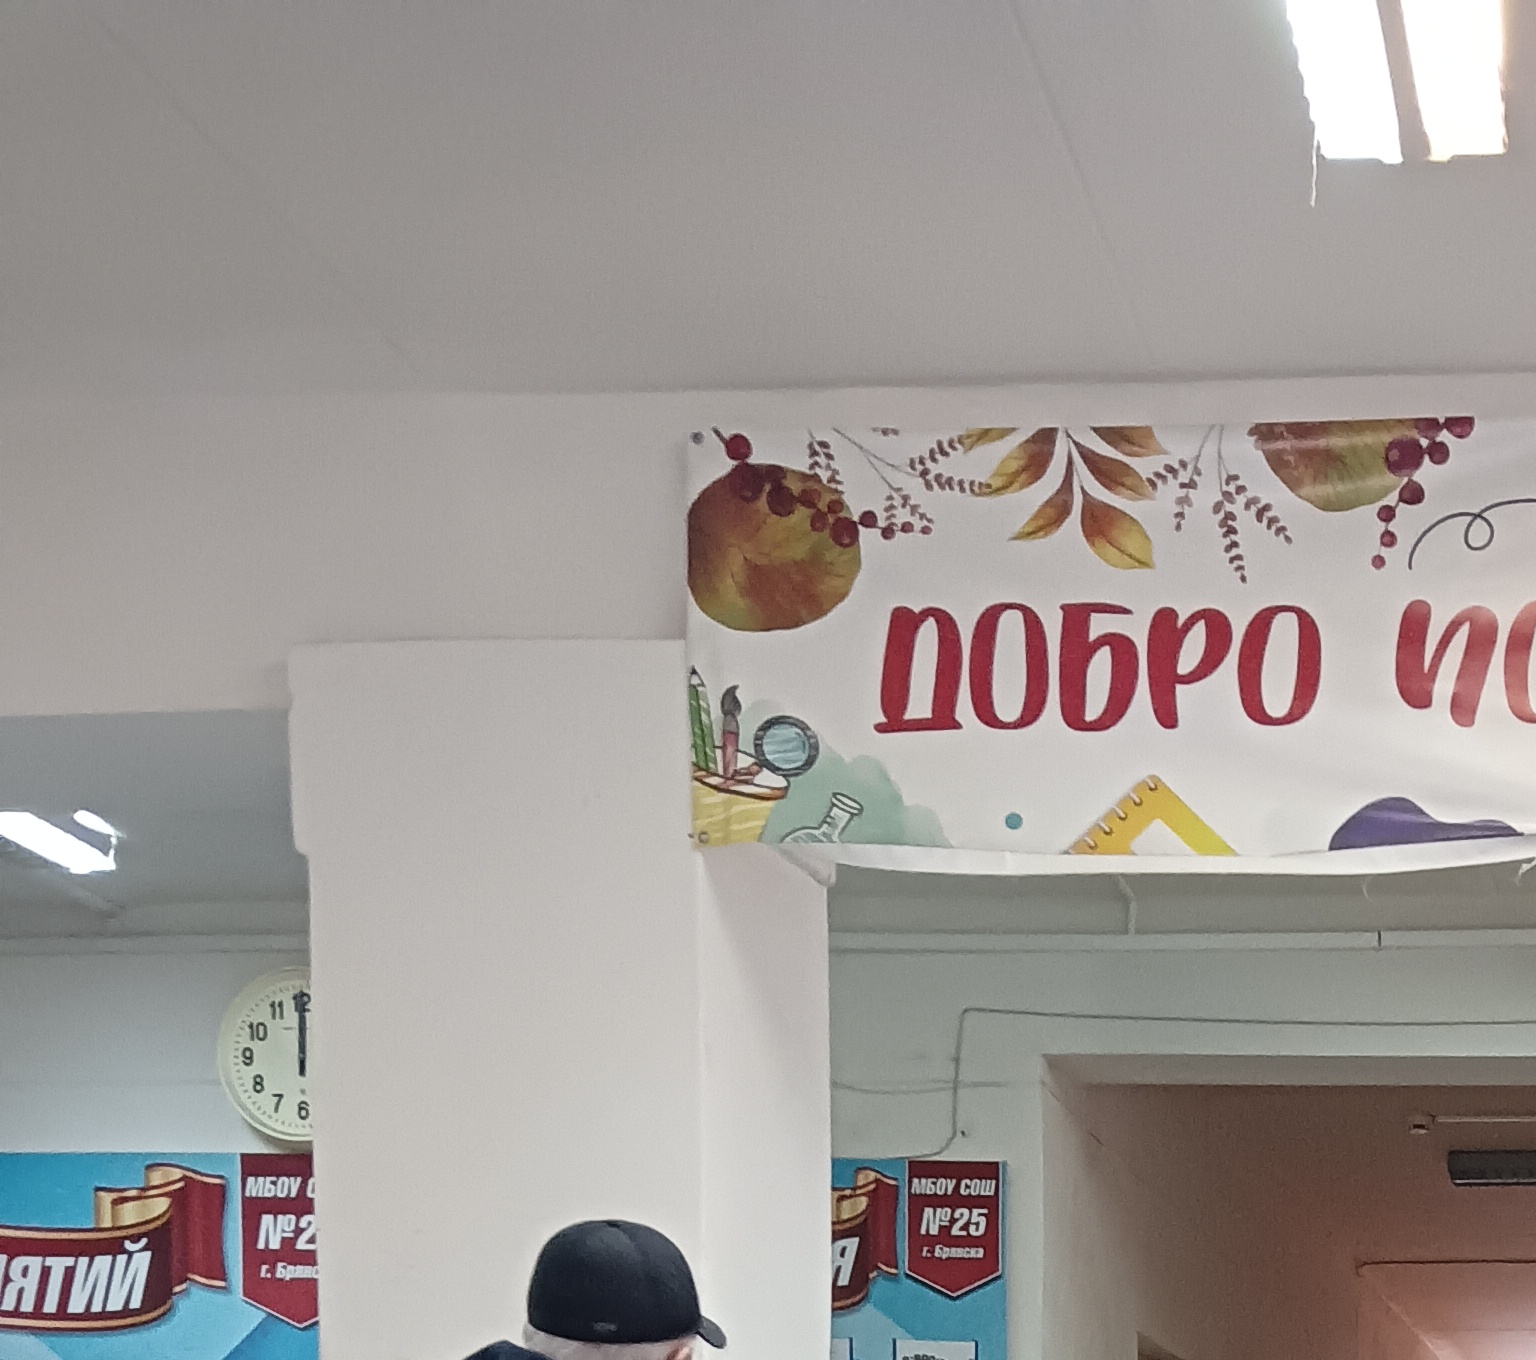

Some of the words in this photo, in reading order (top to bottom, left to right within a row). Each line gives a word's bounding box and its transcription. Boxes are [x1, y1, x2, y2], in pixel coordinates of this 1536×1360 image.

[873, 602, 1322, 734] ДОБРО
[269, 1000, 284, 1020] 11
[248, 1021, 268, 1042] 10
[241, 1046, 254, 1066] 9
[252, 1074, 265, 1094] 8
[271, 1093, 284, 1113] 7
[297, 1100, 309, 1120] 6
[245, 1176, 302, 1198] МБОУ
[911, 1177, 957, 1196] МБОУ
[959, 1178, 997, 1196] СОШ
[920, 1206, 988, 1236] №25
[256, 1213, 318, 1250] №2
[0, 1237, 152, 1314] ЯТИЙ
